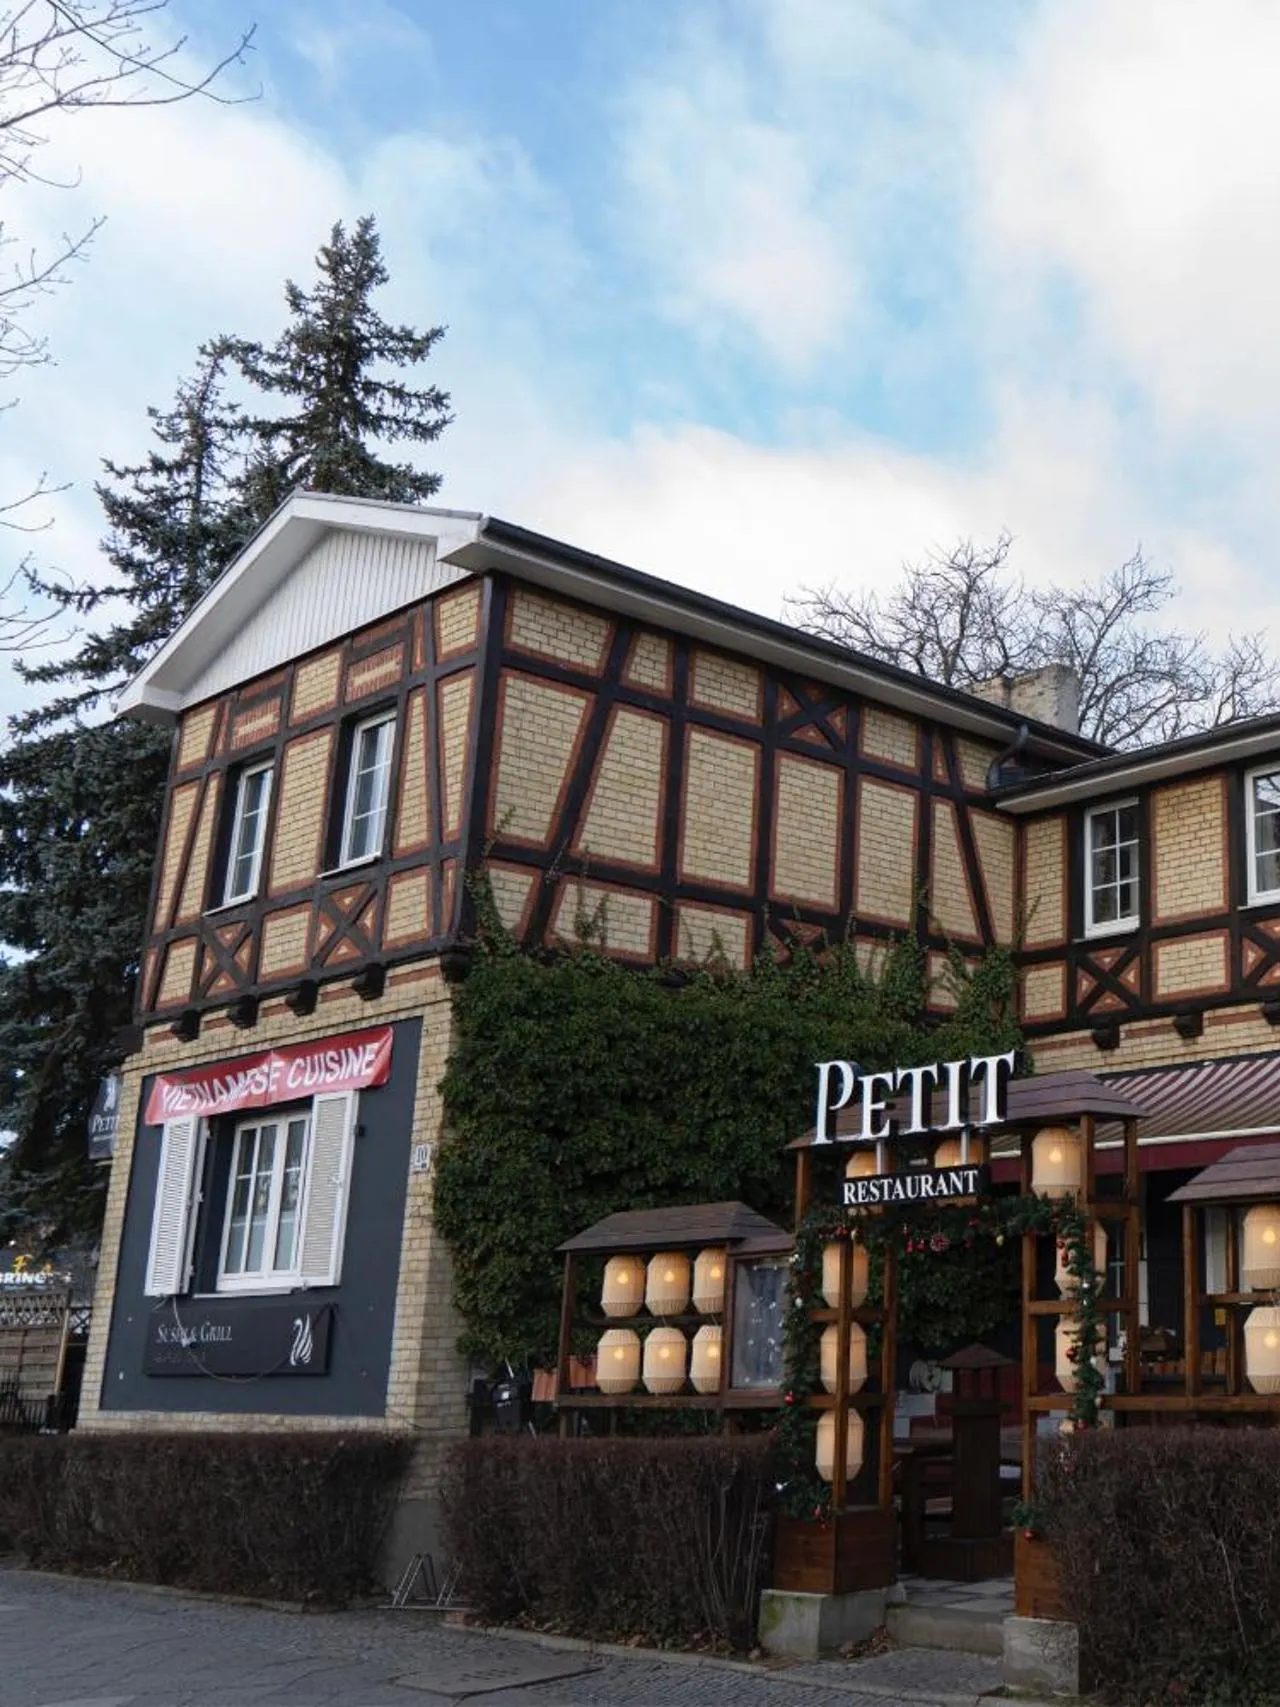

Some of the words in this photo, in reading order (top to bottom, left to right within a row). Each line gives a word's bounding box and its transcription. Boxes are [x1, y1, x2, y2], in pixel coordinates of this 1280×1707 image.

[162, 1060, 286, 1112] VIETNAMESE
[287, 1042, 382, 1089] CUISINE
[810, 1048, 1015, 1145] PETIT
[843, 1169, 979, 1205] RESTAURANT
